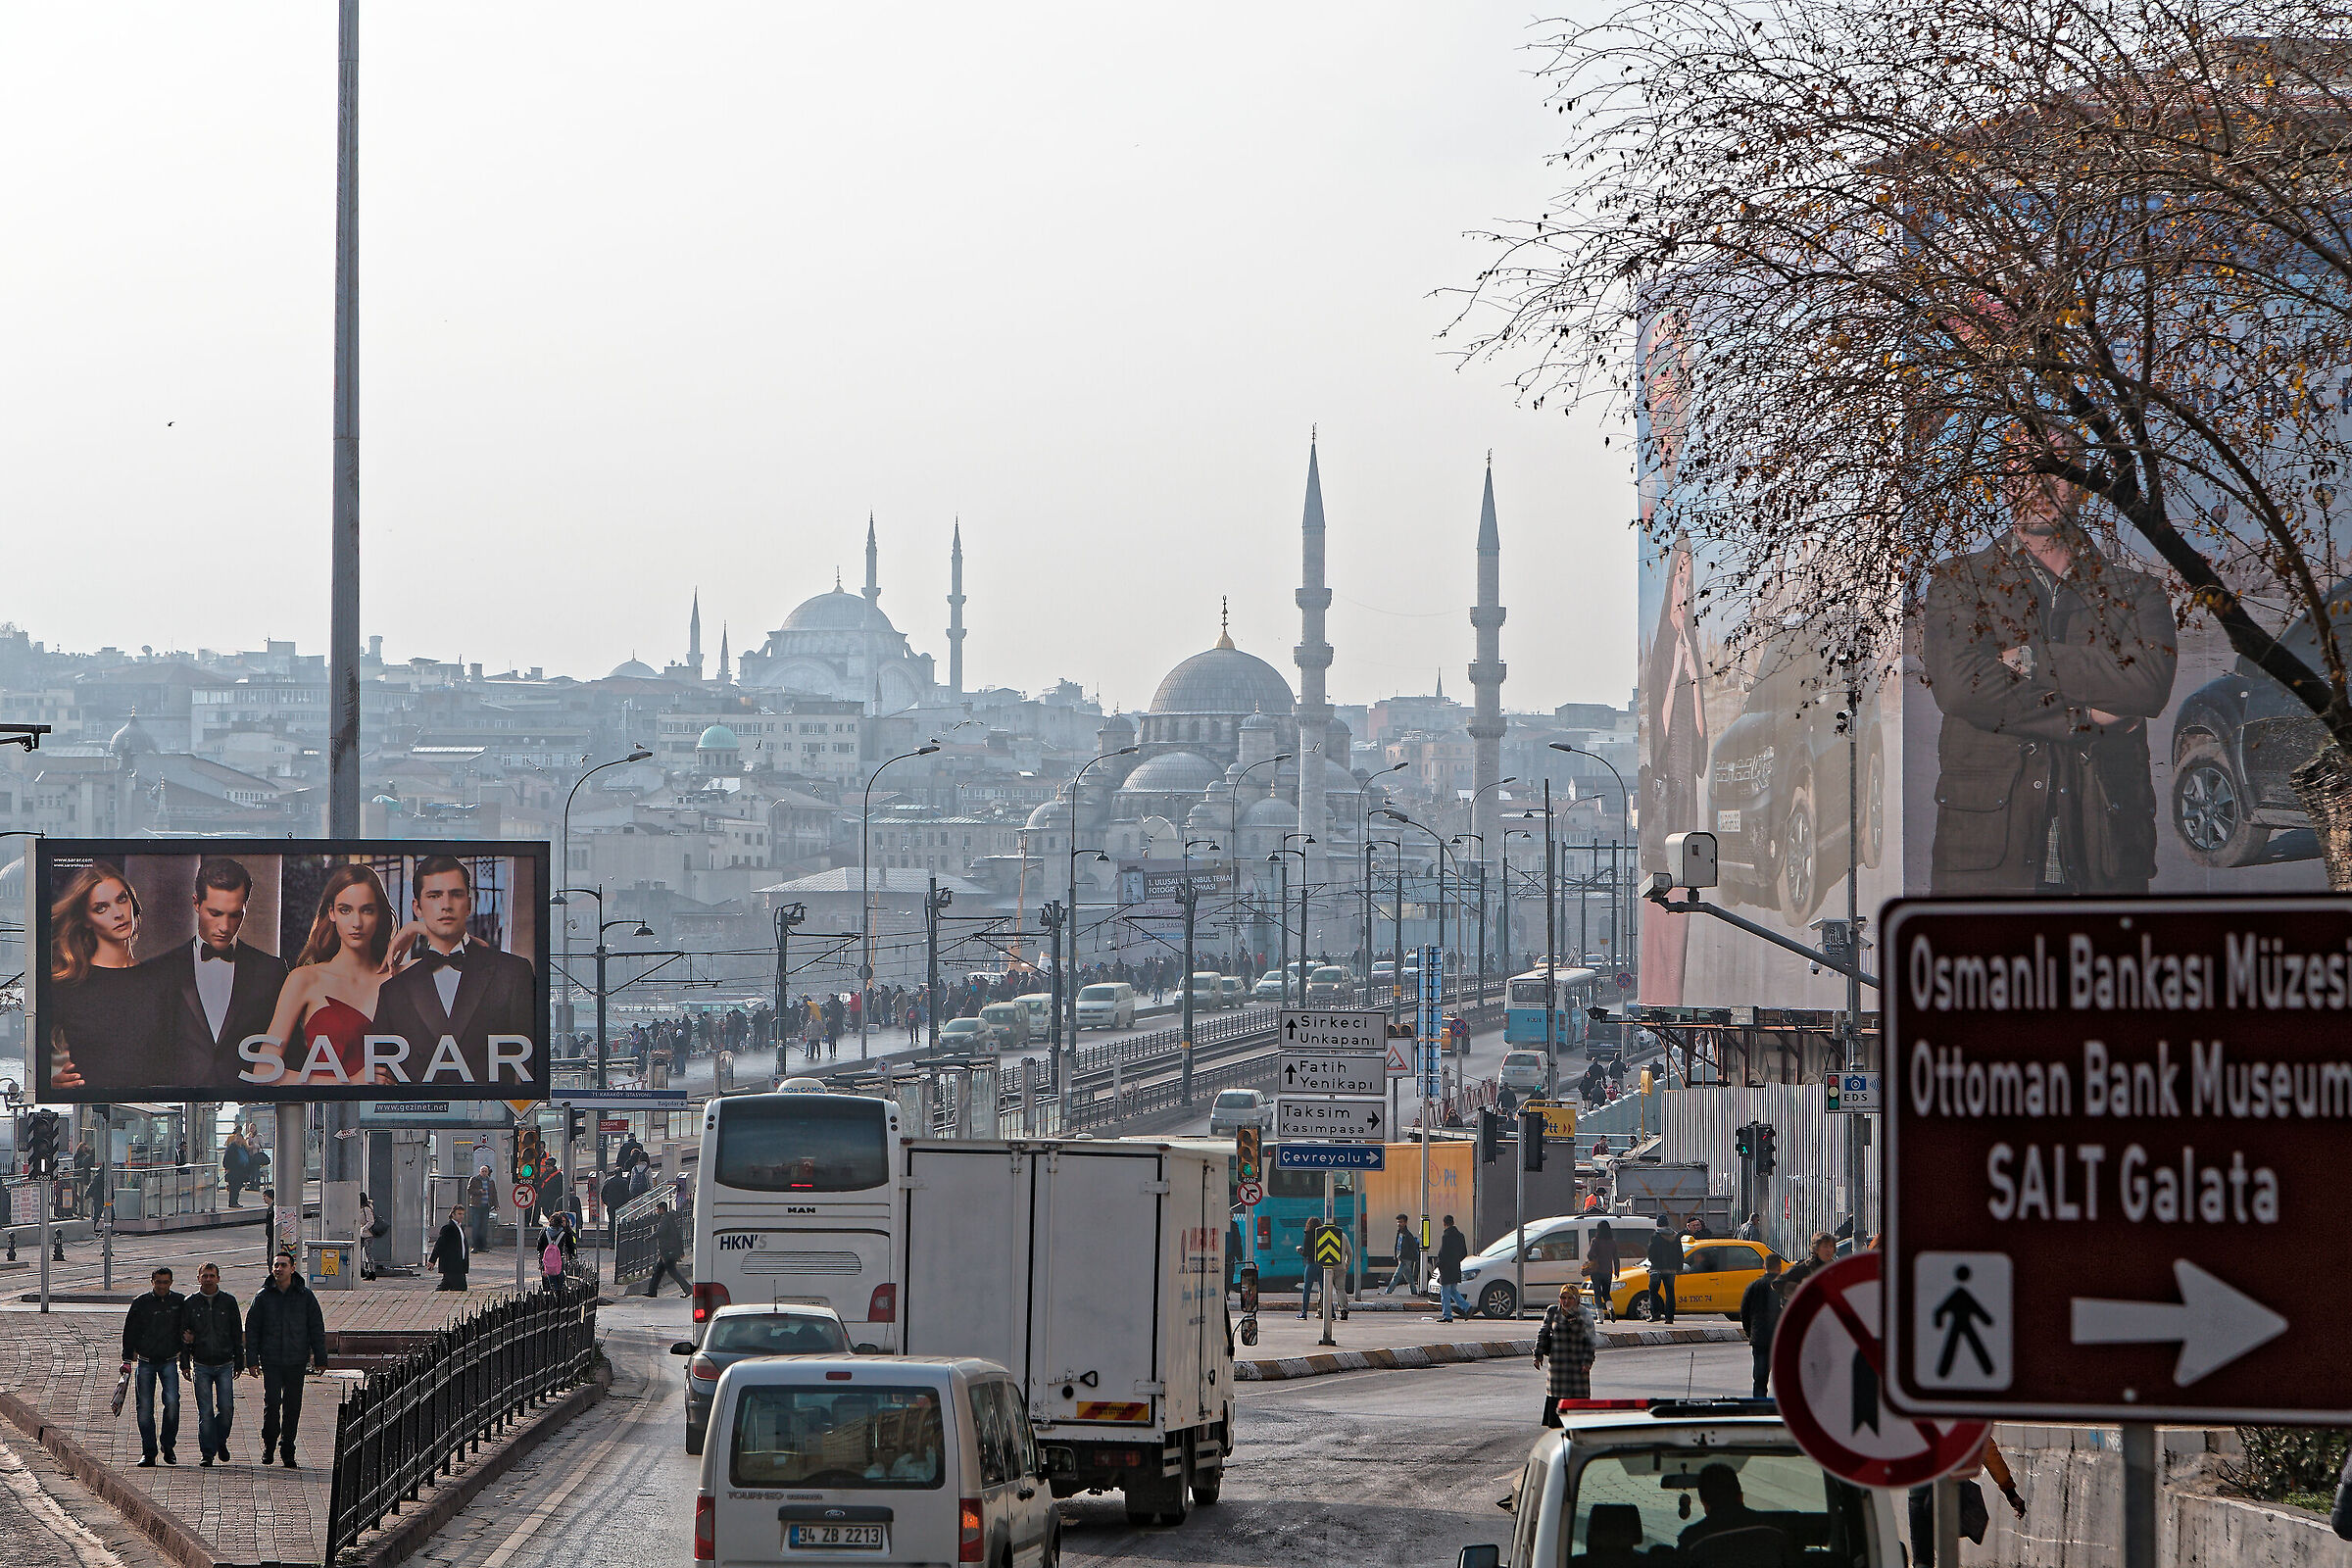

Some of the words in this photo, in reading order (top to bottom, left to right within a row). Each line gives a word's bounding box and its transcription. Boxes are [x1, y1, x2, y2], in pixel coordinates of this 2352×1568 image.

[1154, 877, 1179, 886] ULUSAL
[1909, 934, 2057, 1011] Osmanlı
[2069, 933, 2215, 1010] Bankası
[1300, 1015, 1367, 1029] Sirkeci
[1299, 1033, 1375, 1047] Unkapanı
[237, 1034, 535, 1084] SARAR
[1299, 1060, 1347, 1073] Fatih
[1299, 1077, 1373, 1092] Yenikapı
[1909, 1039, 2072, 1118] Ottoman
[2083, 1039, 2181, 1118] Bank
[2191, 1039, 2352, 1118] Museum
[376, 1102, 448, 1112] www.gezinet.net
[1283, 1104, 1350, 1118] Taksim
[1282, 1122, 1365, 1135] Kasımpaşa
[1282, 1151, 1361, 1164] Çevreyolu
[1986, 1143, 2106, 1221] SALT
[2120, 1143, 2279, 1224] Galata
[727, 1491, 784, 1500] TOURNEO
[799, 1528, 816, 1543] 34
[822, 1528, 839, 1543] ZB
[846, 1528, 880, 1543] 2213
